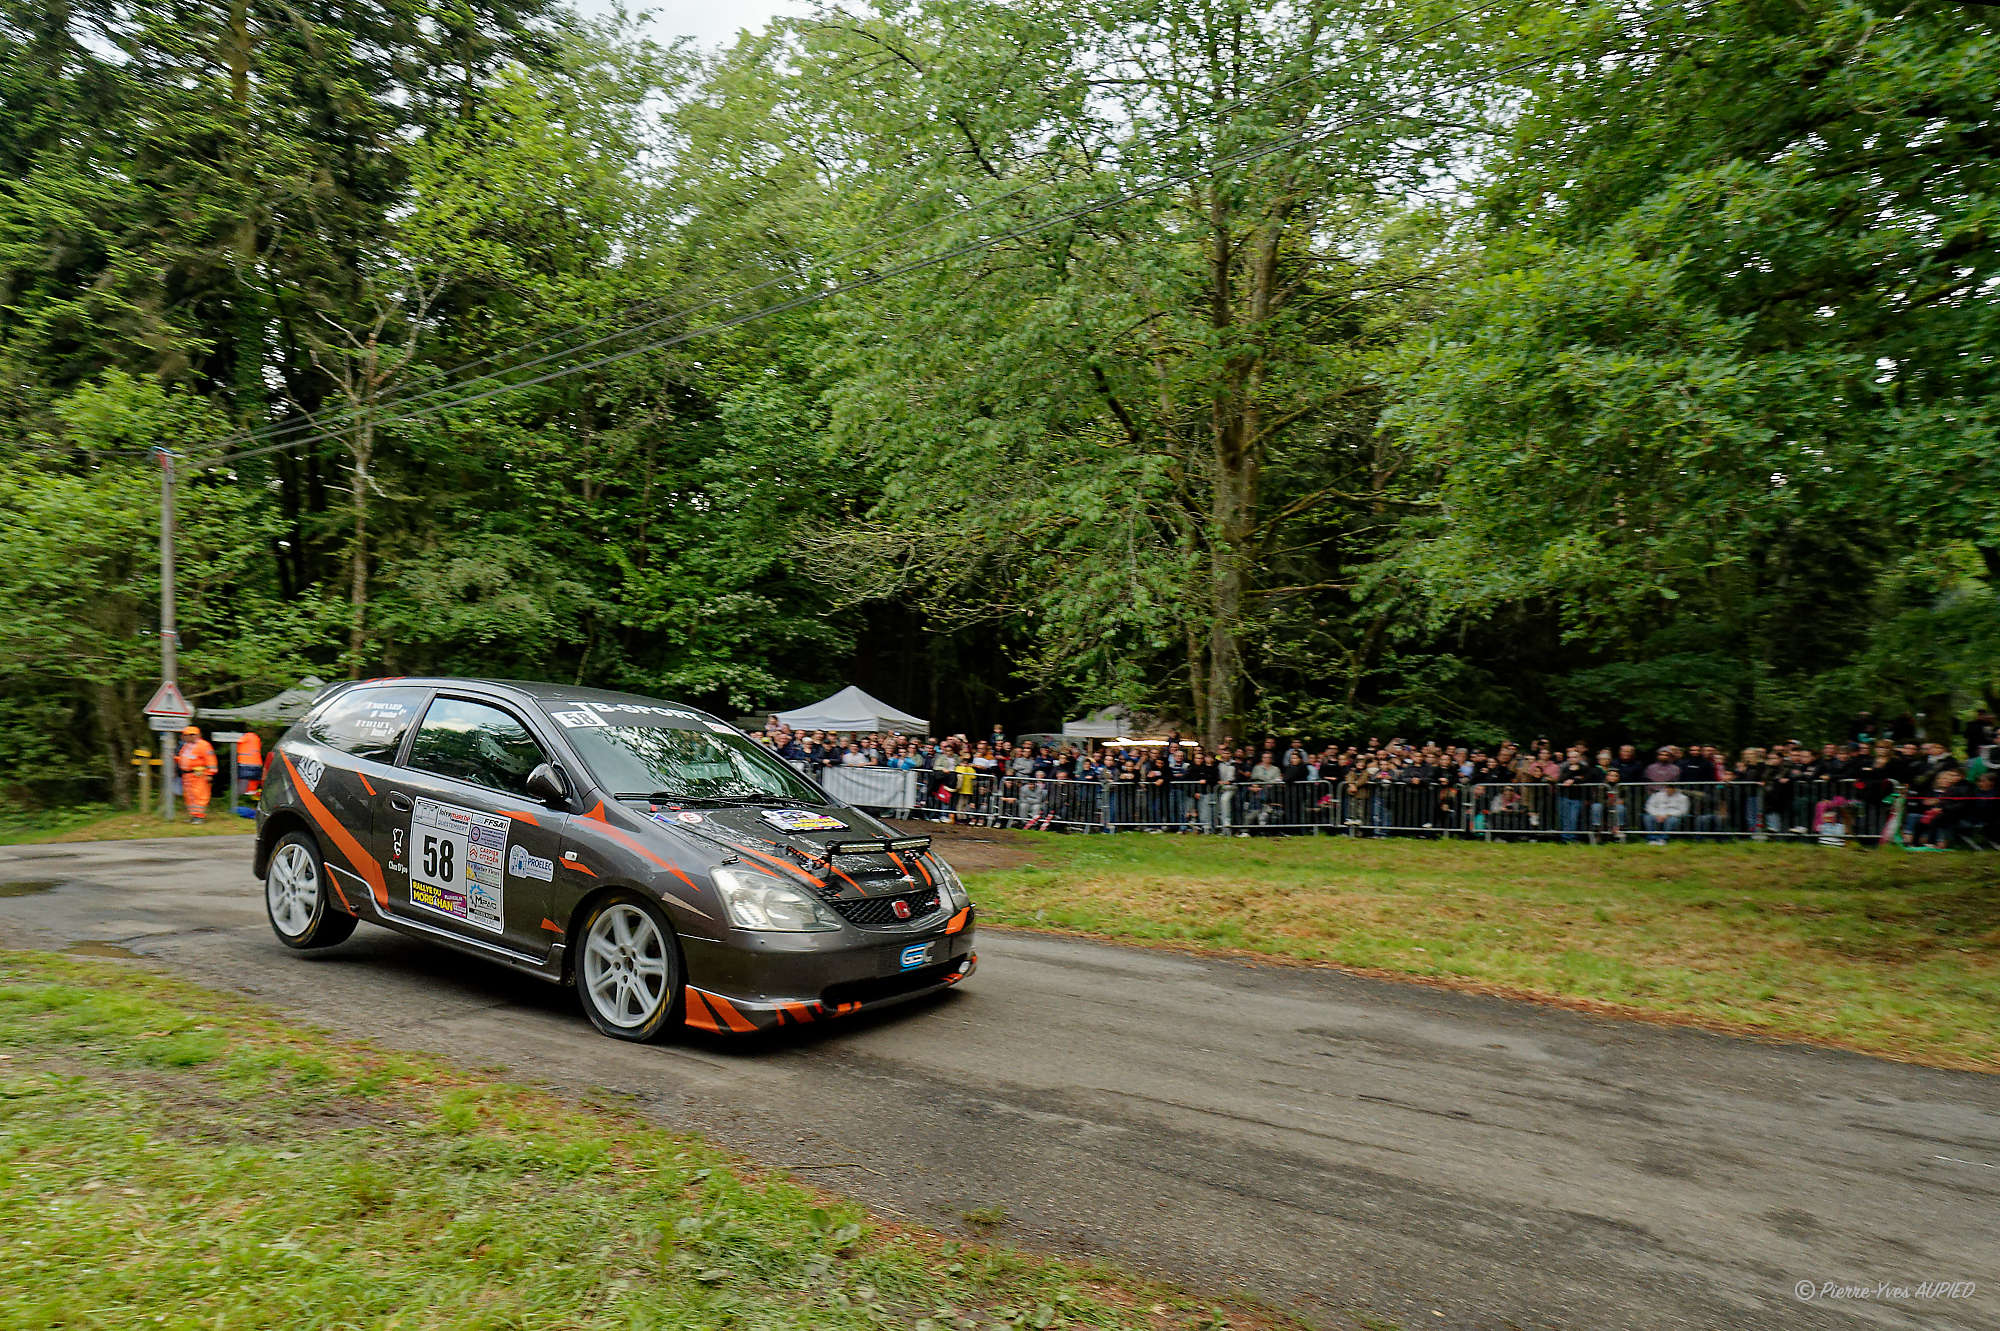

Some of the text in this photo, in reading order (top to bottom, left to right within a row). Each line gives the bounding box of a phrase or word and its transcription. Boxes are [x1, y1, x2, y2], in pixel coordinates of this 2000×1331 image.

[565, 713, 598, 726] 58
[423, 834, 454, 883] 58
[528, 857, 552, 872] PROELEC
[412, 881, 433, 895] RALLYE
